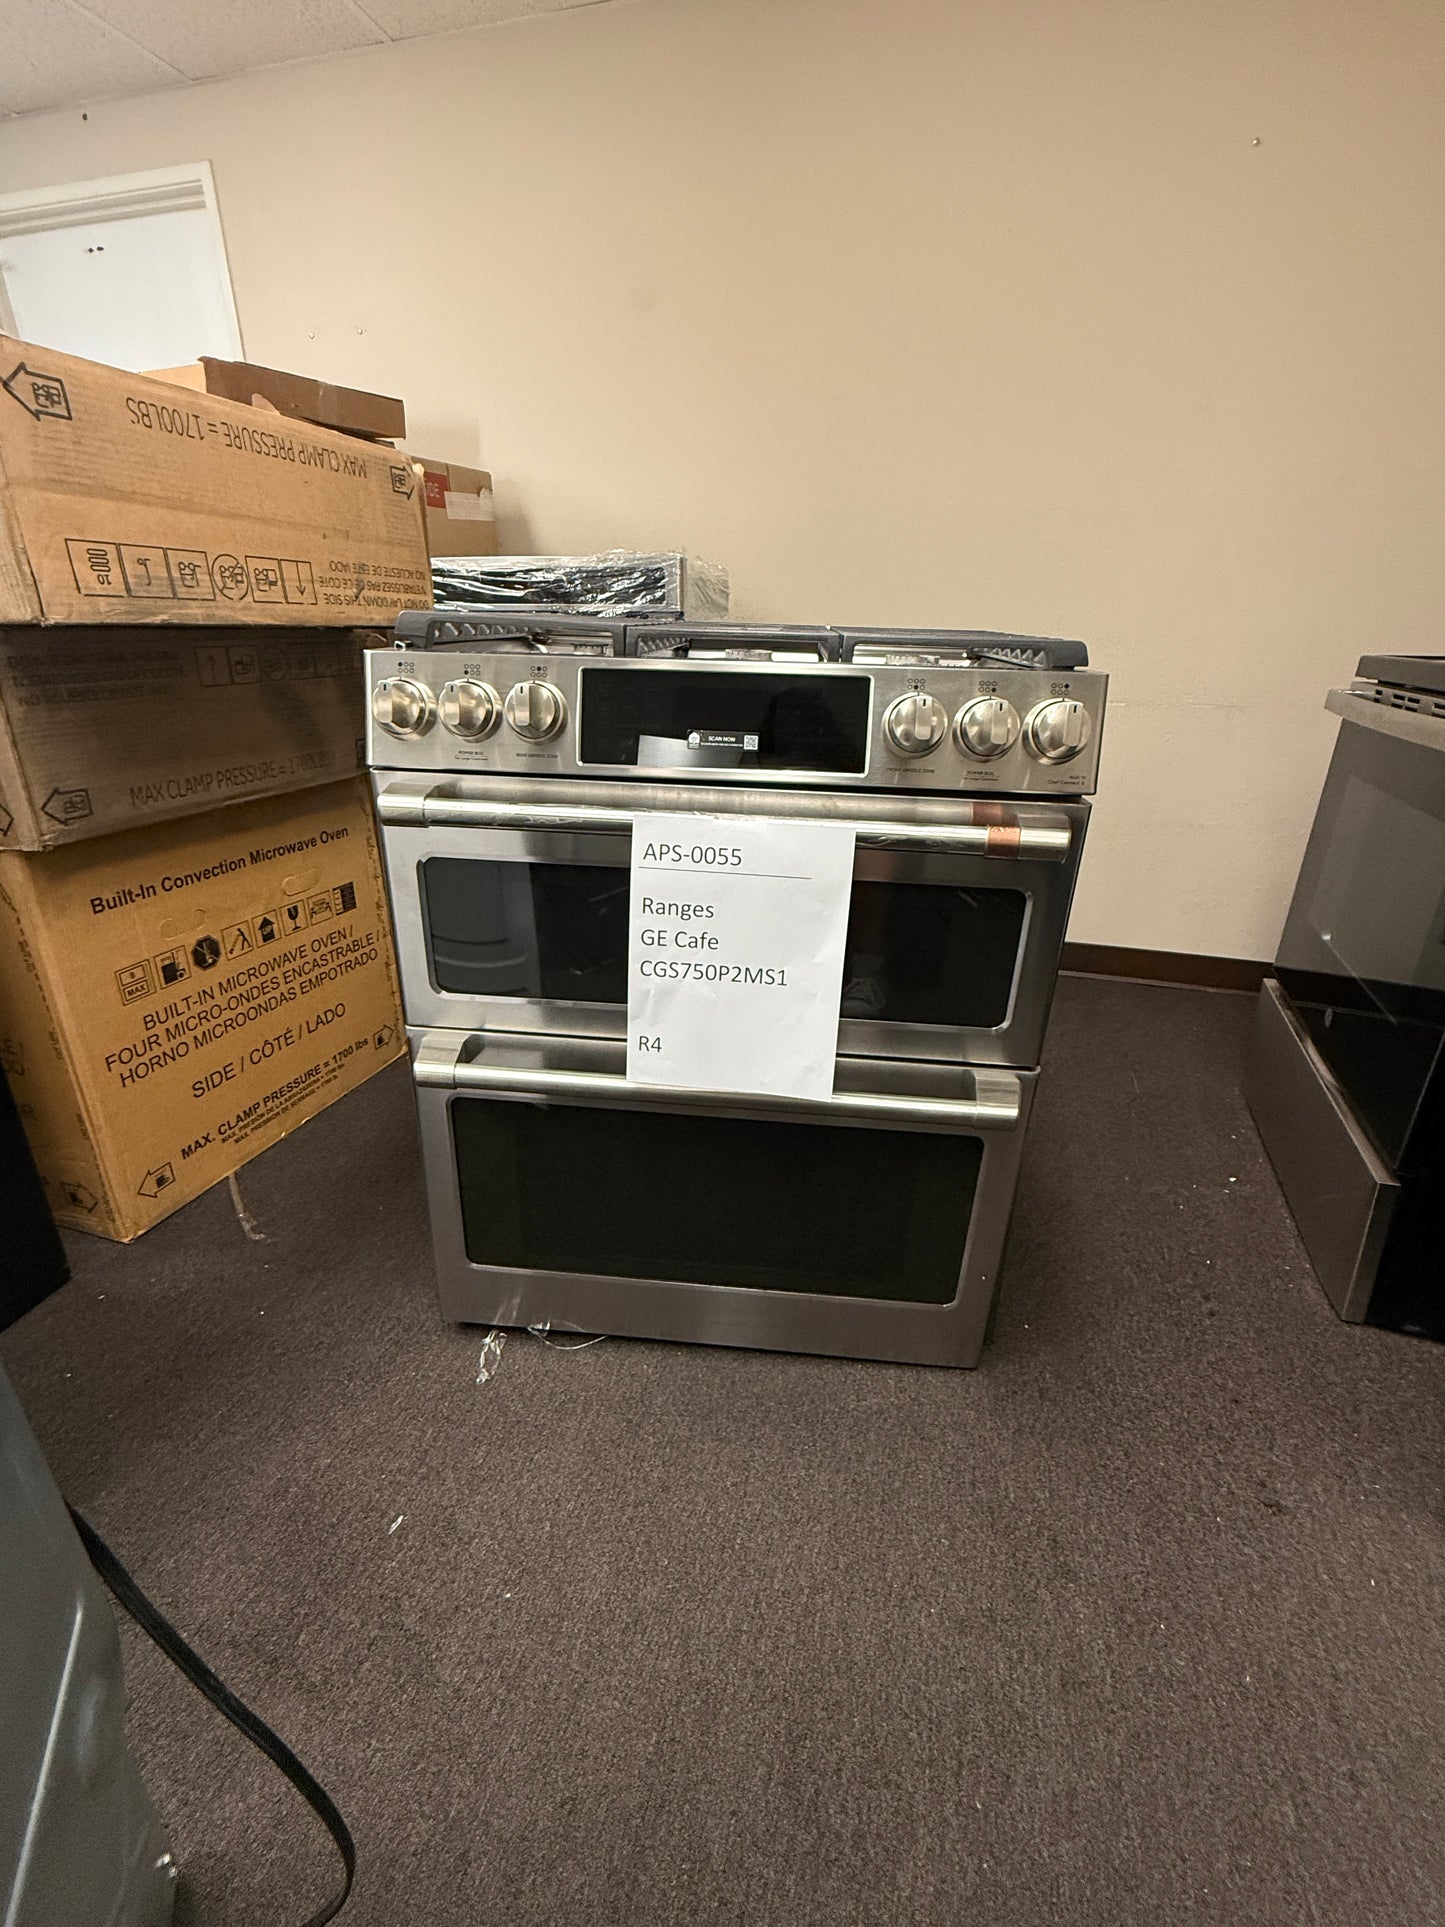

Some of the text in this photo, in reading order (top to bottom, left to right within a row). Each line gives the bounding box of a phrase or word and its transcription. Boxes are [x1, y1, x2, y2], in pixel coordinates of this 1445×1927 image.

[126, 397, 204, 441] 1700LBS
[224, 421, 295, 461] PRESSURE
[299, 446, 340, 473] CLAMP
[340, 455, 368, 478] MAX
[130, 784, 165, 806] MAX
[166, 776, 214, 800] CLAMP
[215, 761, 277, 790] PRESSURE
[90, 827, 349, 915] Built-In Convection Microwave Oven
[642, 843, 743, 867] APS-0055
[641, 897, 715, 921] Ranges
[262, 924, 273, 935] UP
[640, 929, 720, 950] GE Cafe
[143, 987, 215, 1031] BUILT-IN
[218, 950, 307, 1000] MICROWAVE
[311, 934, 346, 953] OVEN
[640, 960, 788, 987] CGS750P2MS1
[105, 1034, 161, 1073] FOUR
[166, 977, 280, 1042] MICRO-ONDES
[284, 939, 374, 985] ENCASTRABLE
[127, 984, 146, 999] MAX
[119, 1042, 189, 1088] HORNO
[194, 987, 297, 1050] MICROONDAS
[300, 948, 378, 995] EMPOTRADO
[192, 1063, 236, 1099] SIDE
[249, 1027, 295, 1065] CÔTÉ
[306, 1002, 347, 1035] LADO
[638, 1036, 663, 1053] R4
[180, 1132, 215, 1160] MAX.
[218, 1102, 261, 1135] CLAMP
[263, 1064, 321, 1108] PRESSURE
[332, 1046, 354, 1064] 1700
[355, 1038, 369, 1051] lbs
